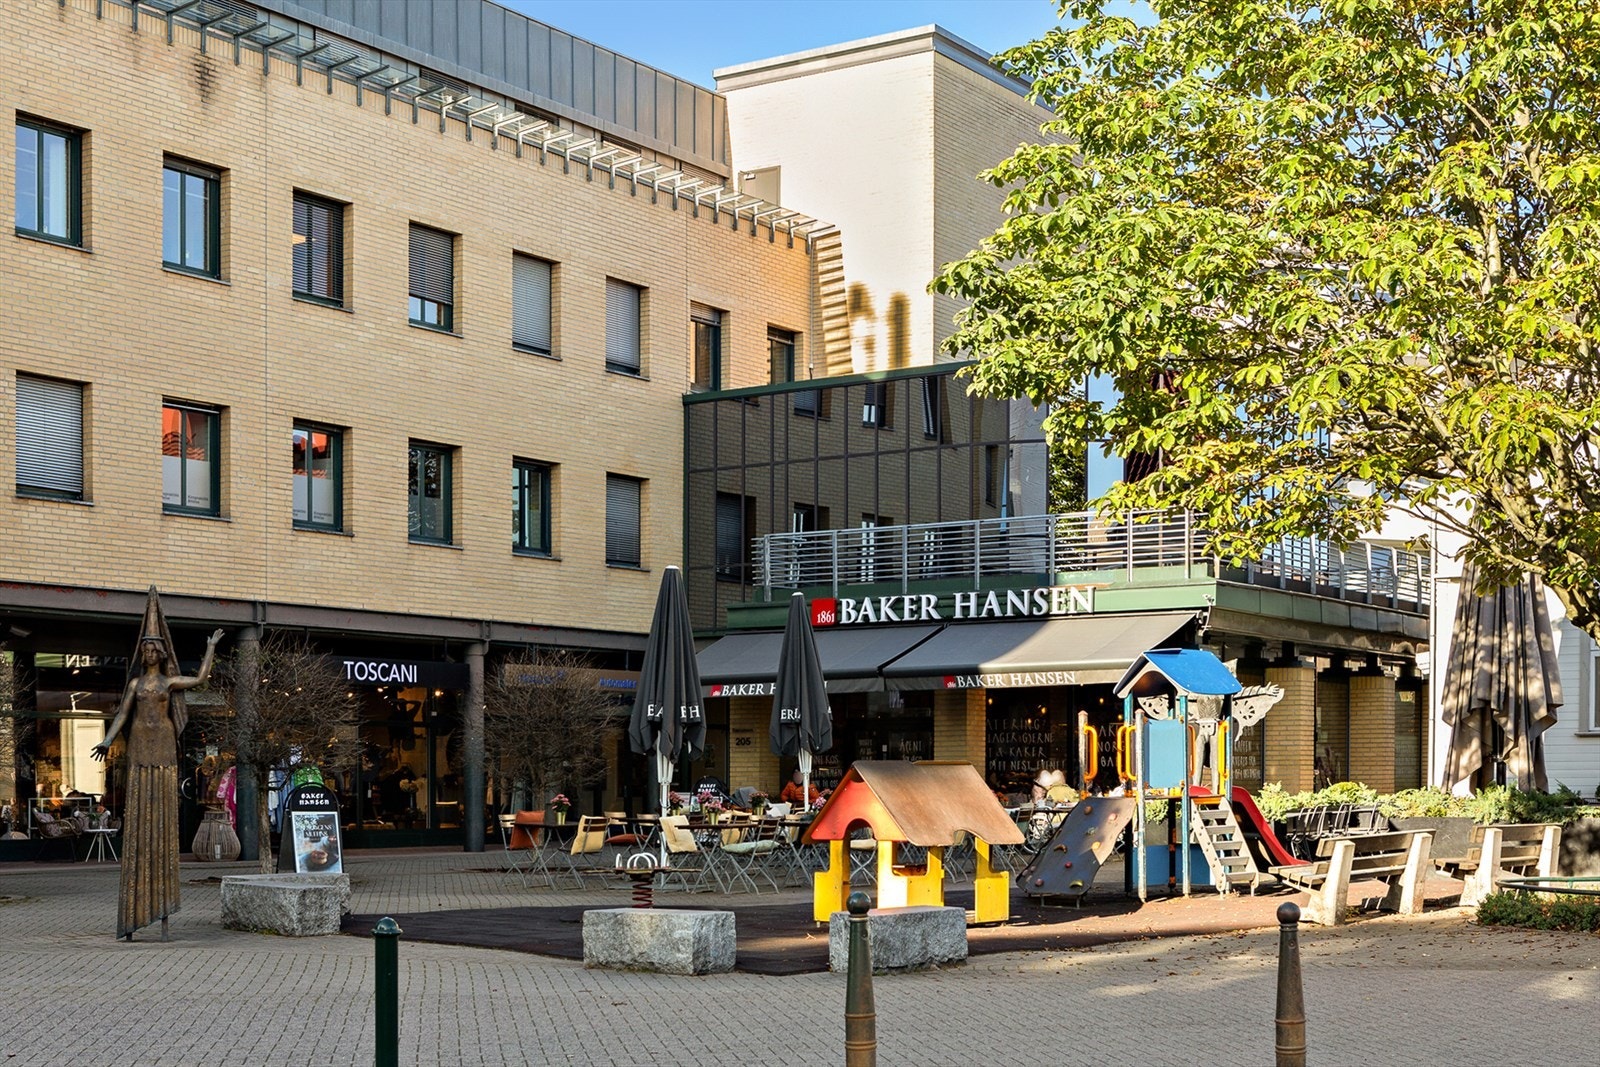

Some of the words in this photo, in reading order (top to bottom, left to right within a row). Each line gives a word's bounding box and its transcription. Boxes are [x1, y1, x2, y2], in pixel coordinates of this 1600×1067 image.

[839, 594, 942, 625] BAKER
[953, 586, 1097, 620] HANSEN
[817, 612, 835, 624] 1861
[343, 661, 418, 683] TOSCANI
[956, 674, 1007, 689] BAKER
[1010, 671, 1077, 687] HANSEN
[721, 683, 765, 698] BAKER
[735, 737, 751, 746] 205
